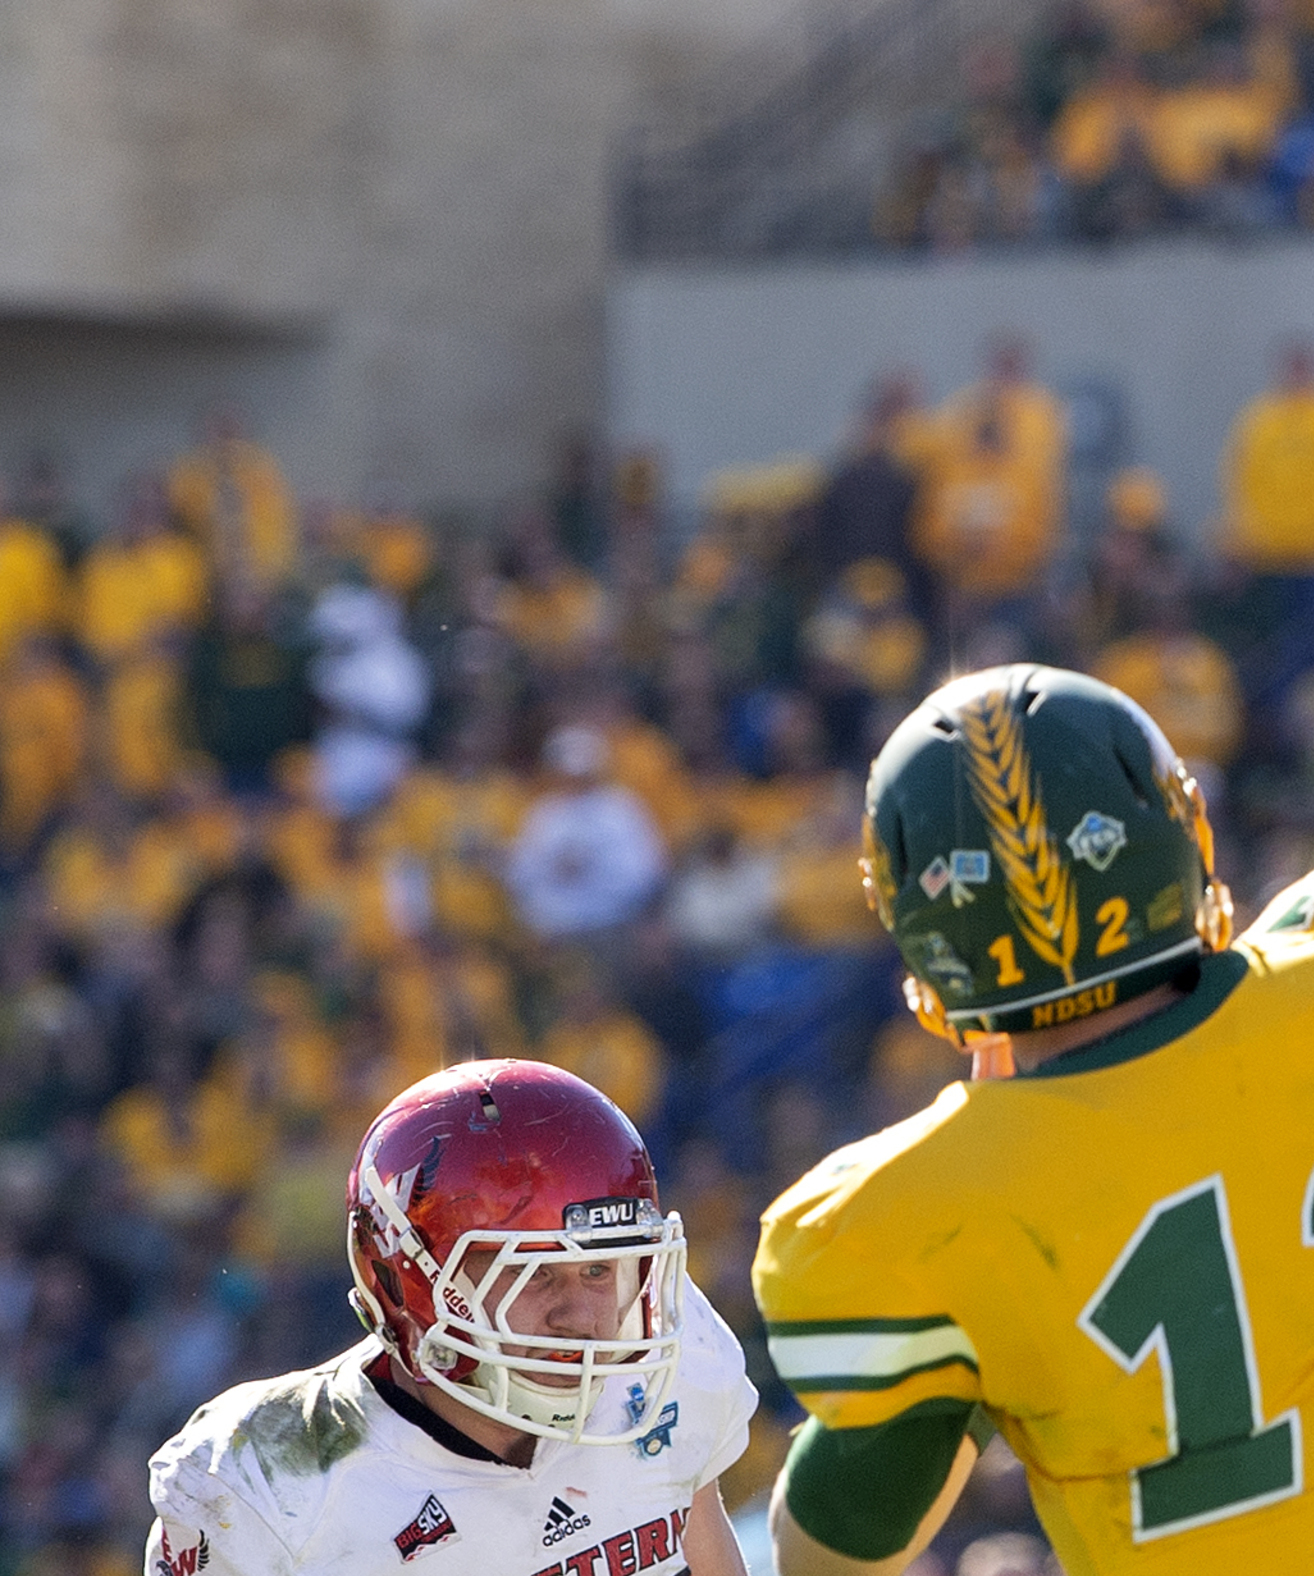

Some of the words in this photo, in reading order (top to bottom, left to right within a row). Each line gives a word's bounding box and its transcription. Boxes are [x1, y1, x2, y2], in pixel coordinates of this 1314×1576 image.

[988, 935, 1025, 988] 1
[1096, 897, 1130, 958] 2
[1032, 981, 1117, 1029] NDSU
[589, 1203, 633, 1226] EWU
[396, 1522, 424, 1549] BIG
[417, 1498, 448, 1535] SKY
[542, 1513, 591, 1547] adidas
